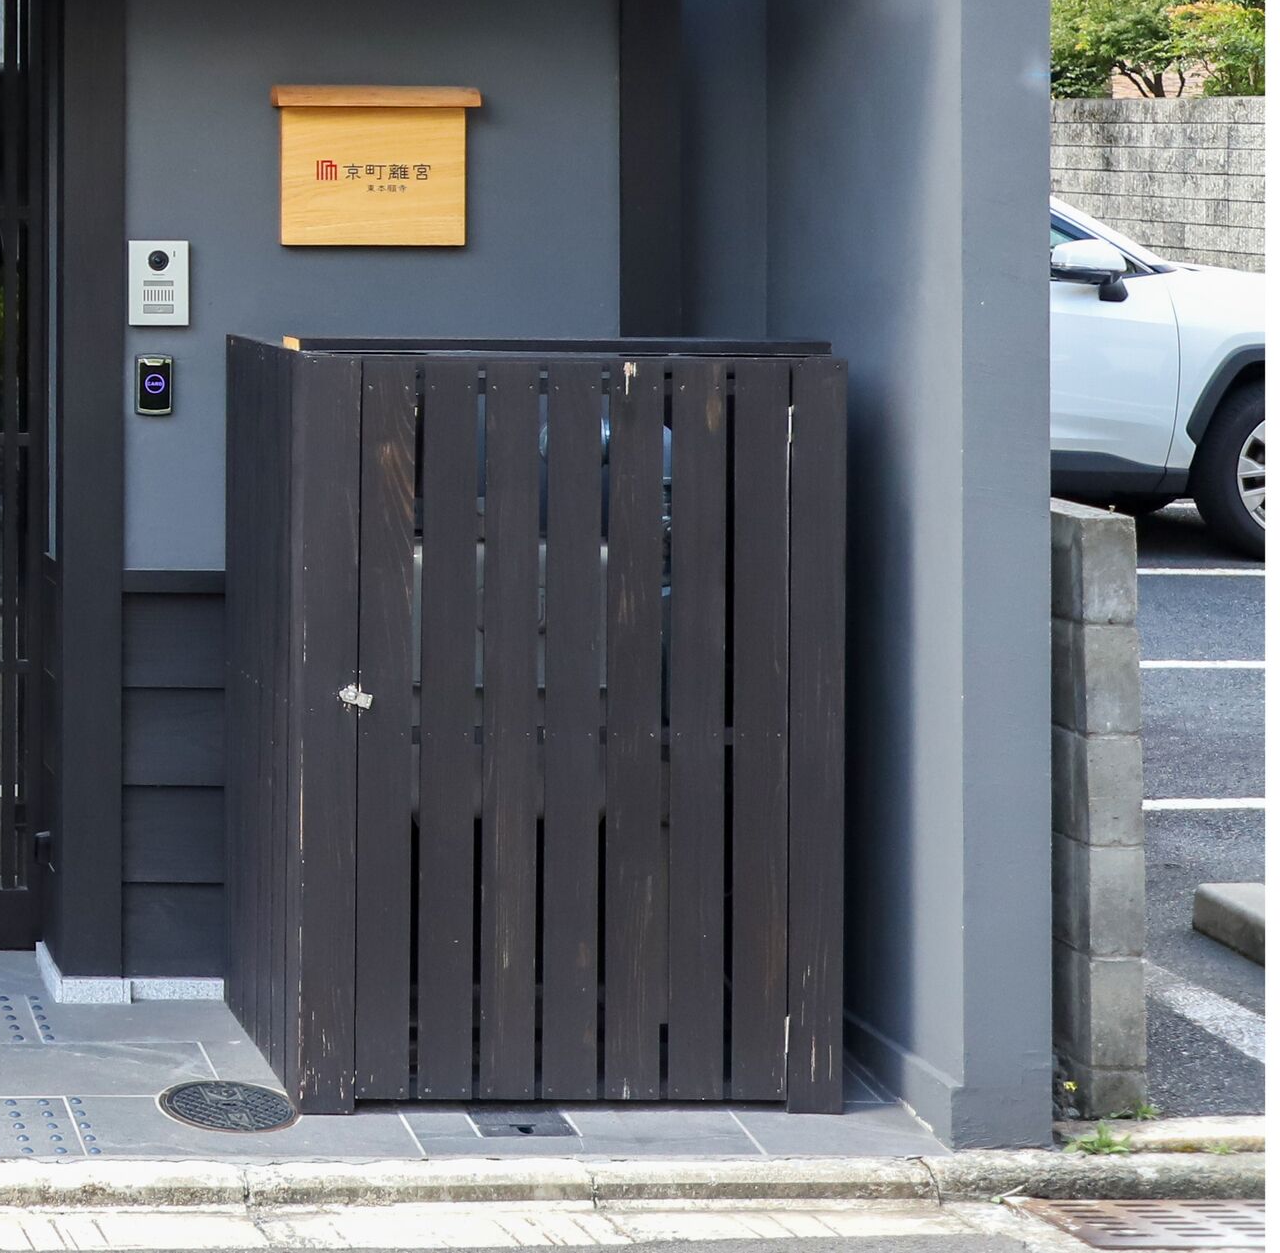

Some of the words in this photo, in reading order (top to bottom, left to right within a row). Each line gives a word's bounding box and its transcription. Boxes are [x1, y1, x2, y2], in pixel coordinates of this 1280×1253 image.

[342, 163, 432, 181] 京町離宮
[366, 184, 408, 193] 東本願寺
